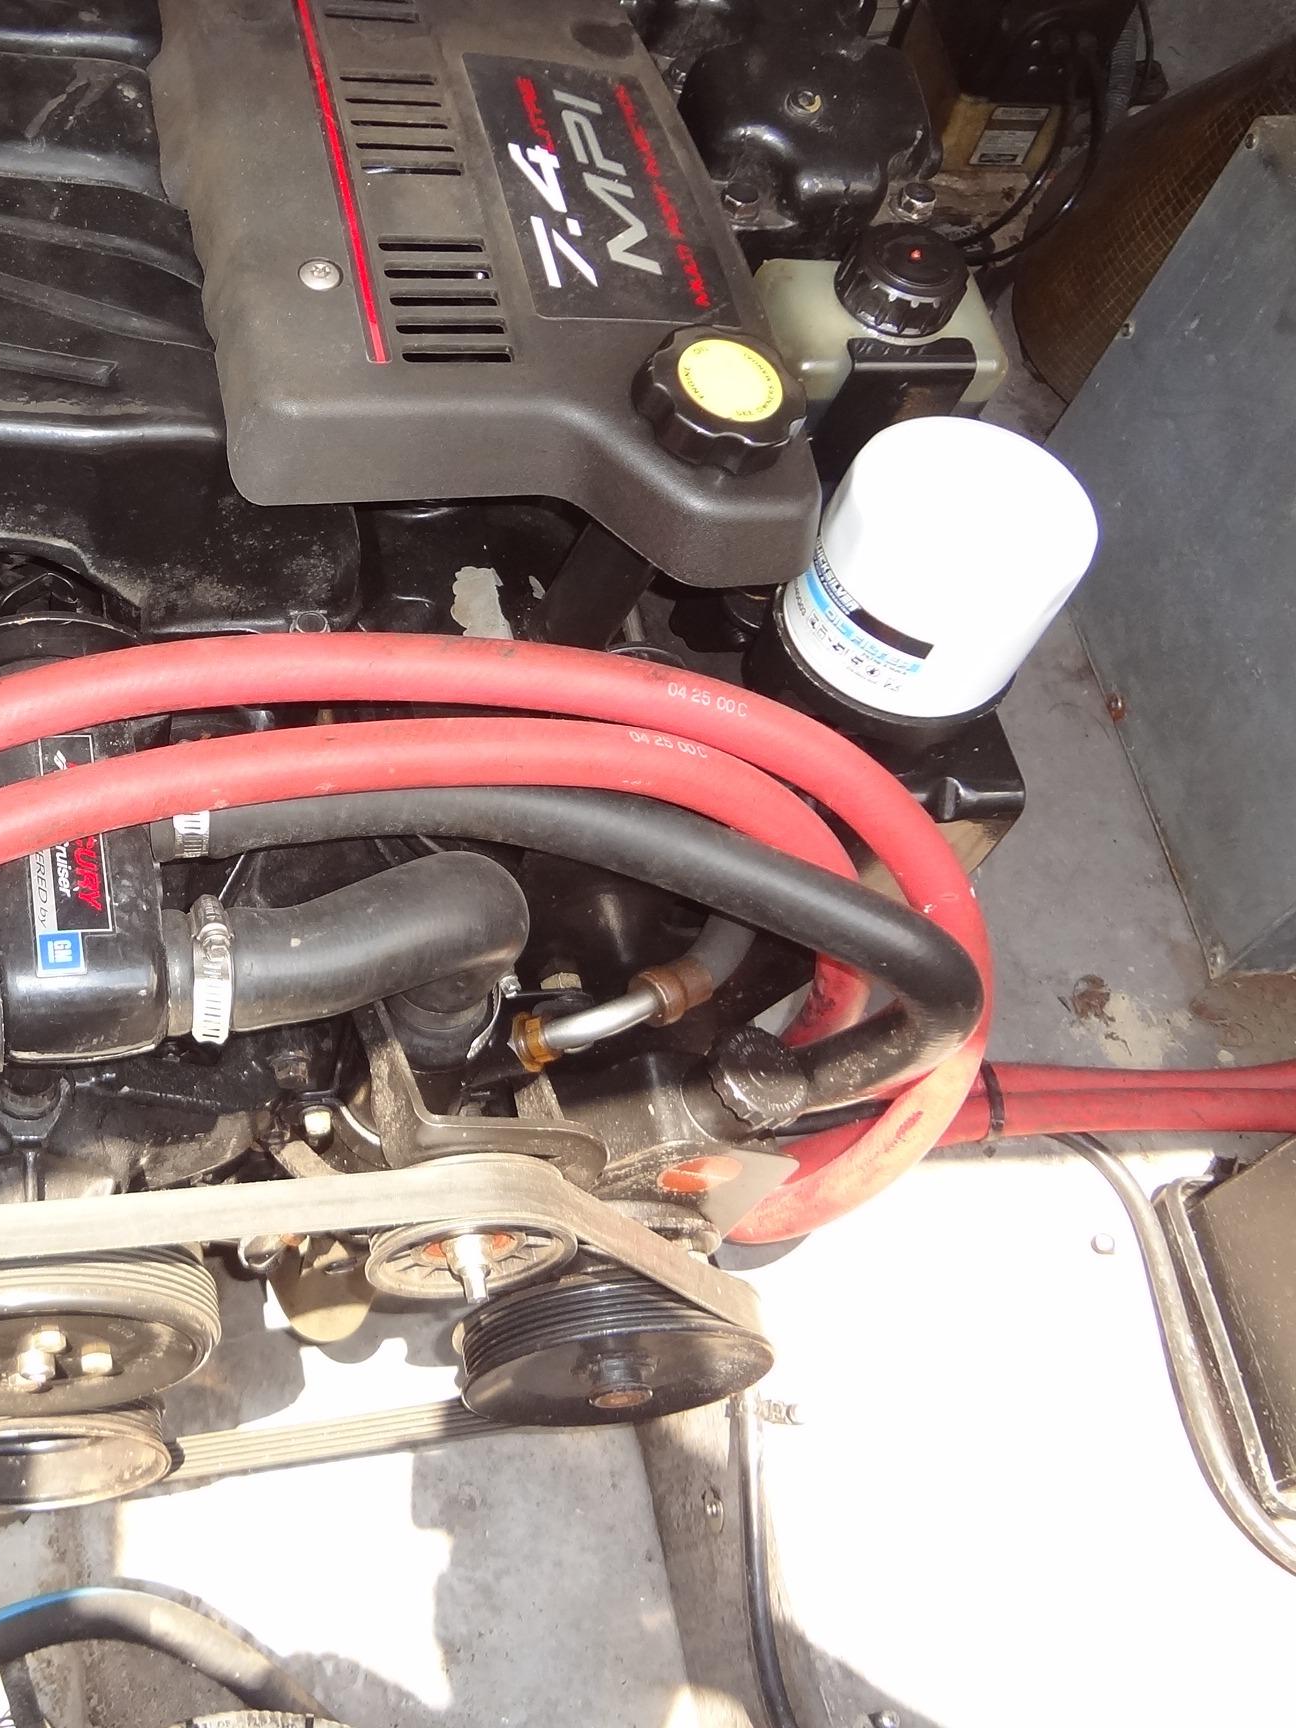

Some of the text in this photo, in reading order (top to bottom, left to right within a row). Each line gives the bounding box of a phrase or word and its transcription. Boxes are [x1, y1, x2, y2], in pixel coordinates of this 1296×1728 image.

[553, 89, 663, 275] MPI
[507, 142, 598, 288] 7.4
[668, 682, 687, 699] 04
[691, 688, 711, 705] 25
[629, 731, 650, 744] 04
[654, 736, 673, 748] 25
[35, 850, 48, 928] ERED by
[55, 842, 71, 898] ruiser
[49, 939, 73, 964] GM
